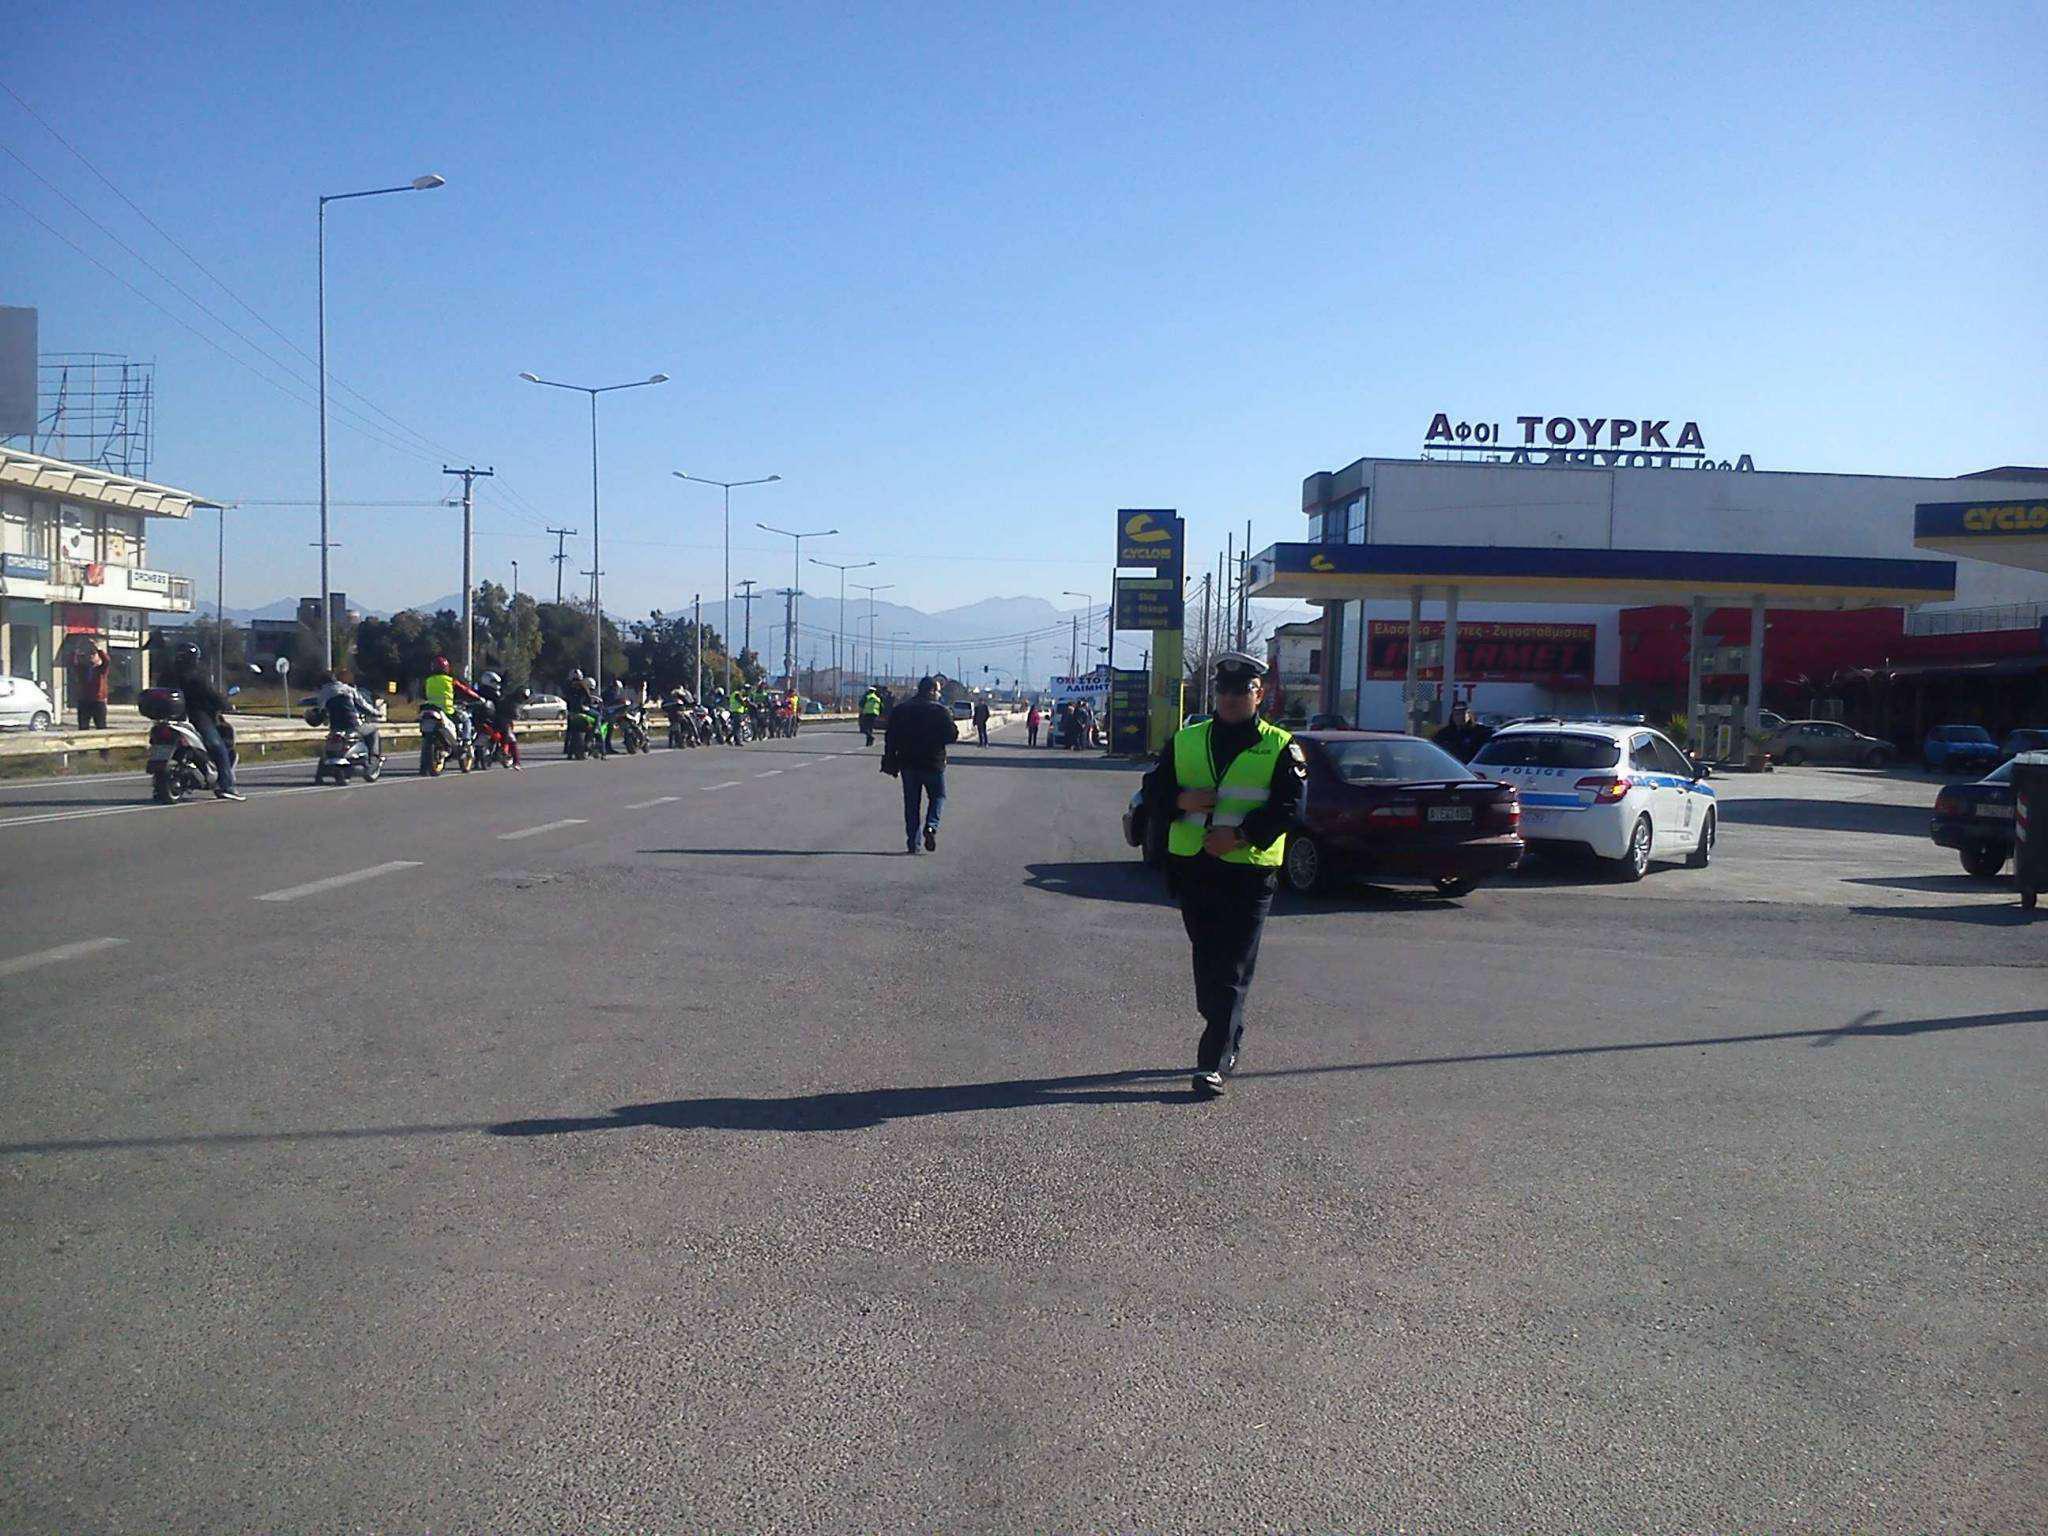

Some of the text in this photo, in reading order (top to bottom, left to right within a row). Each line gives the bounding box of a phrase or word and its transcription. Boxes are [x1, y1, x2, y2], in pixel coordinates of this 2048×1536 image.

[1517, 417, 1705, 449] ΤΟΥΡΚΑ
[1964, 507, 2048, 530] CYCLO
[1500, 766, 1566, 777] POLICE
